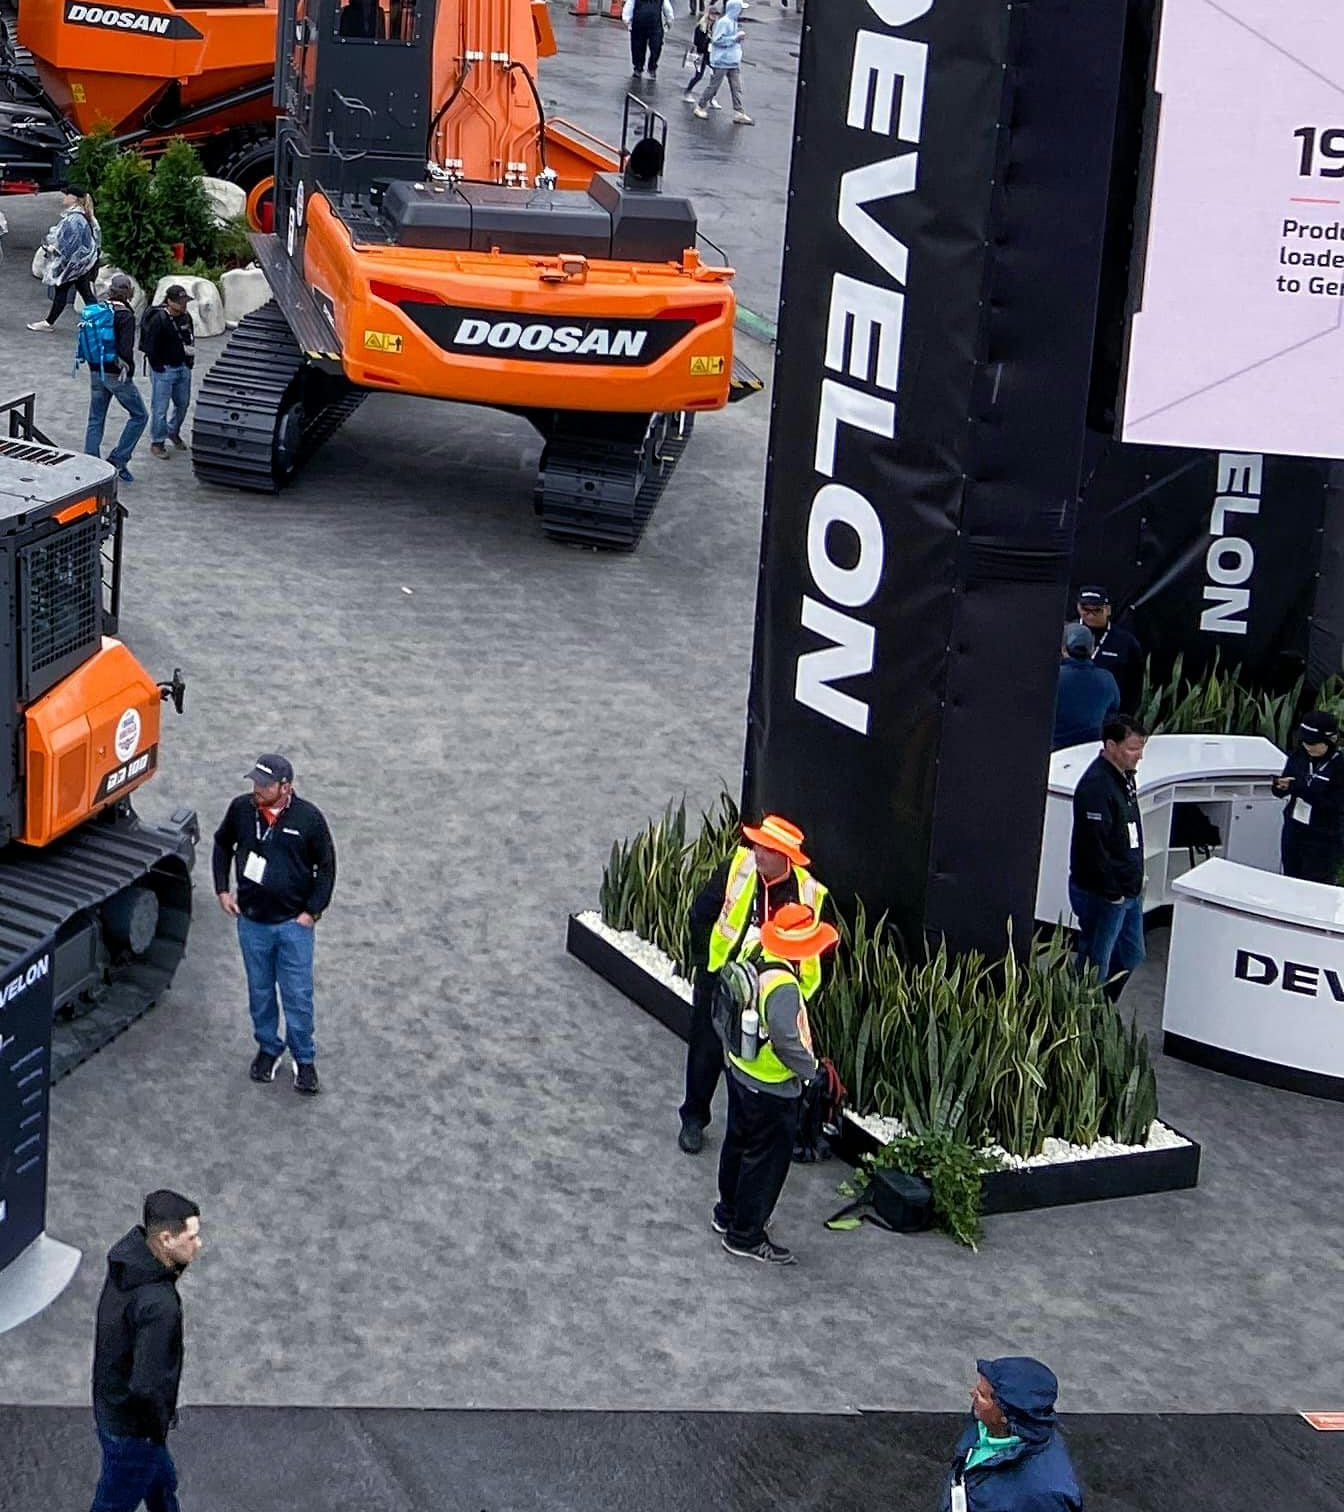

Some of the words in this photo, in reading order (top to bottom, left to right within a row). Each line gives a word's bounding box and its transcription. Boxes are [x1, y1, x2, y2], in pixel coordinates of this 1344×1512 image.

[67, 5, 170, 35] DOOSAN
[1282, 219, 1344, 241] Prod
[1276, 274, 1300, 293] to
[453, 318, 647, 356] DOOSAN
